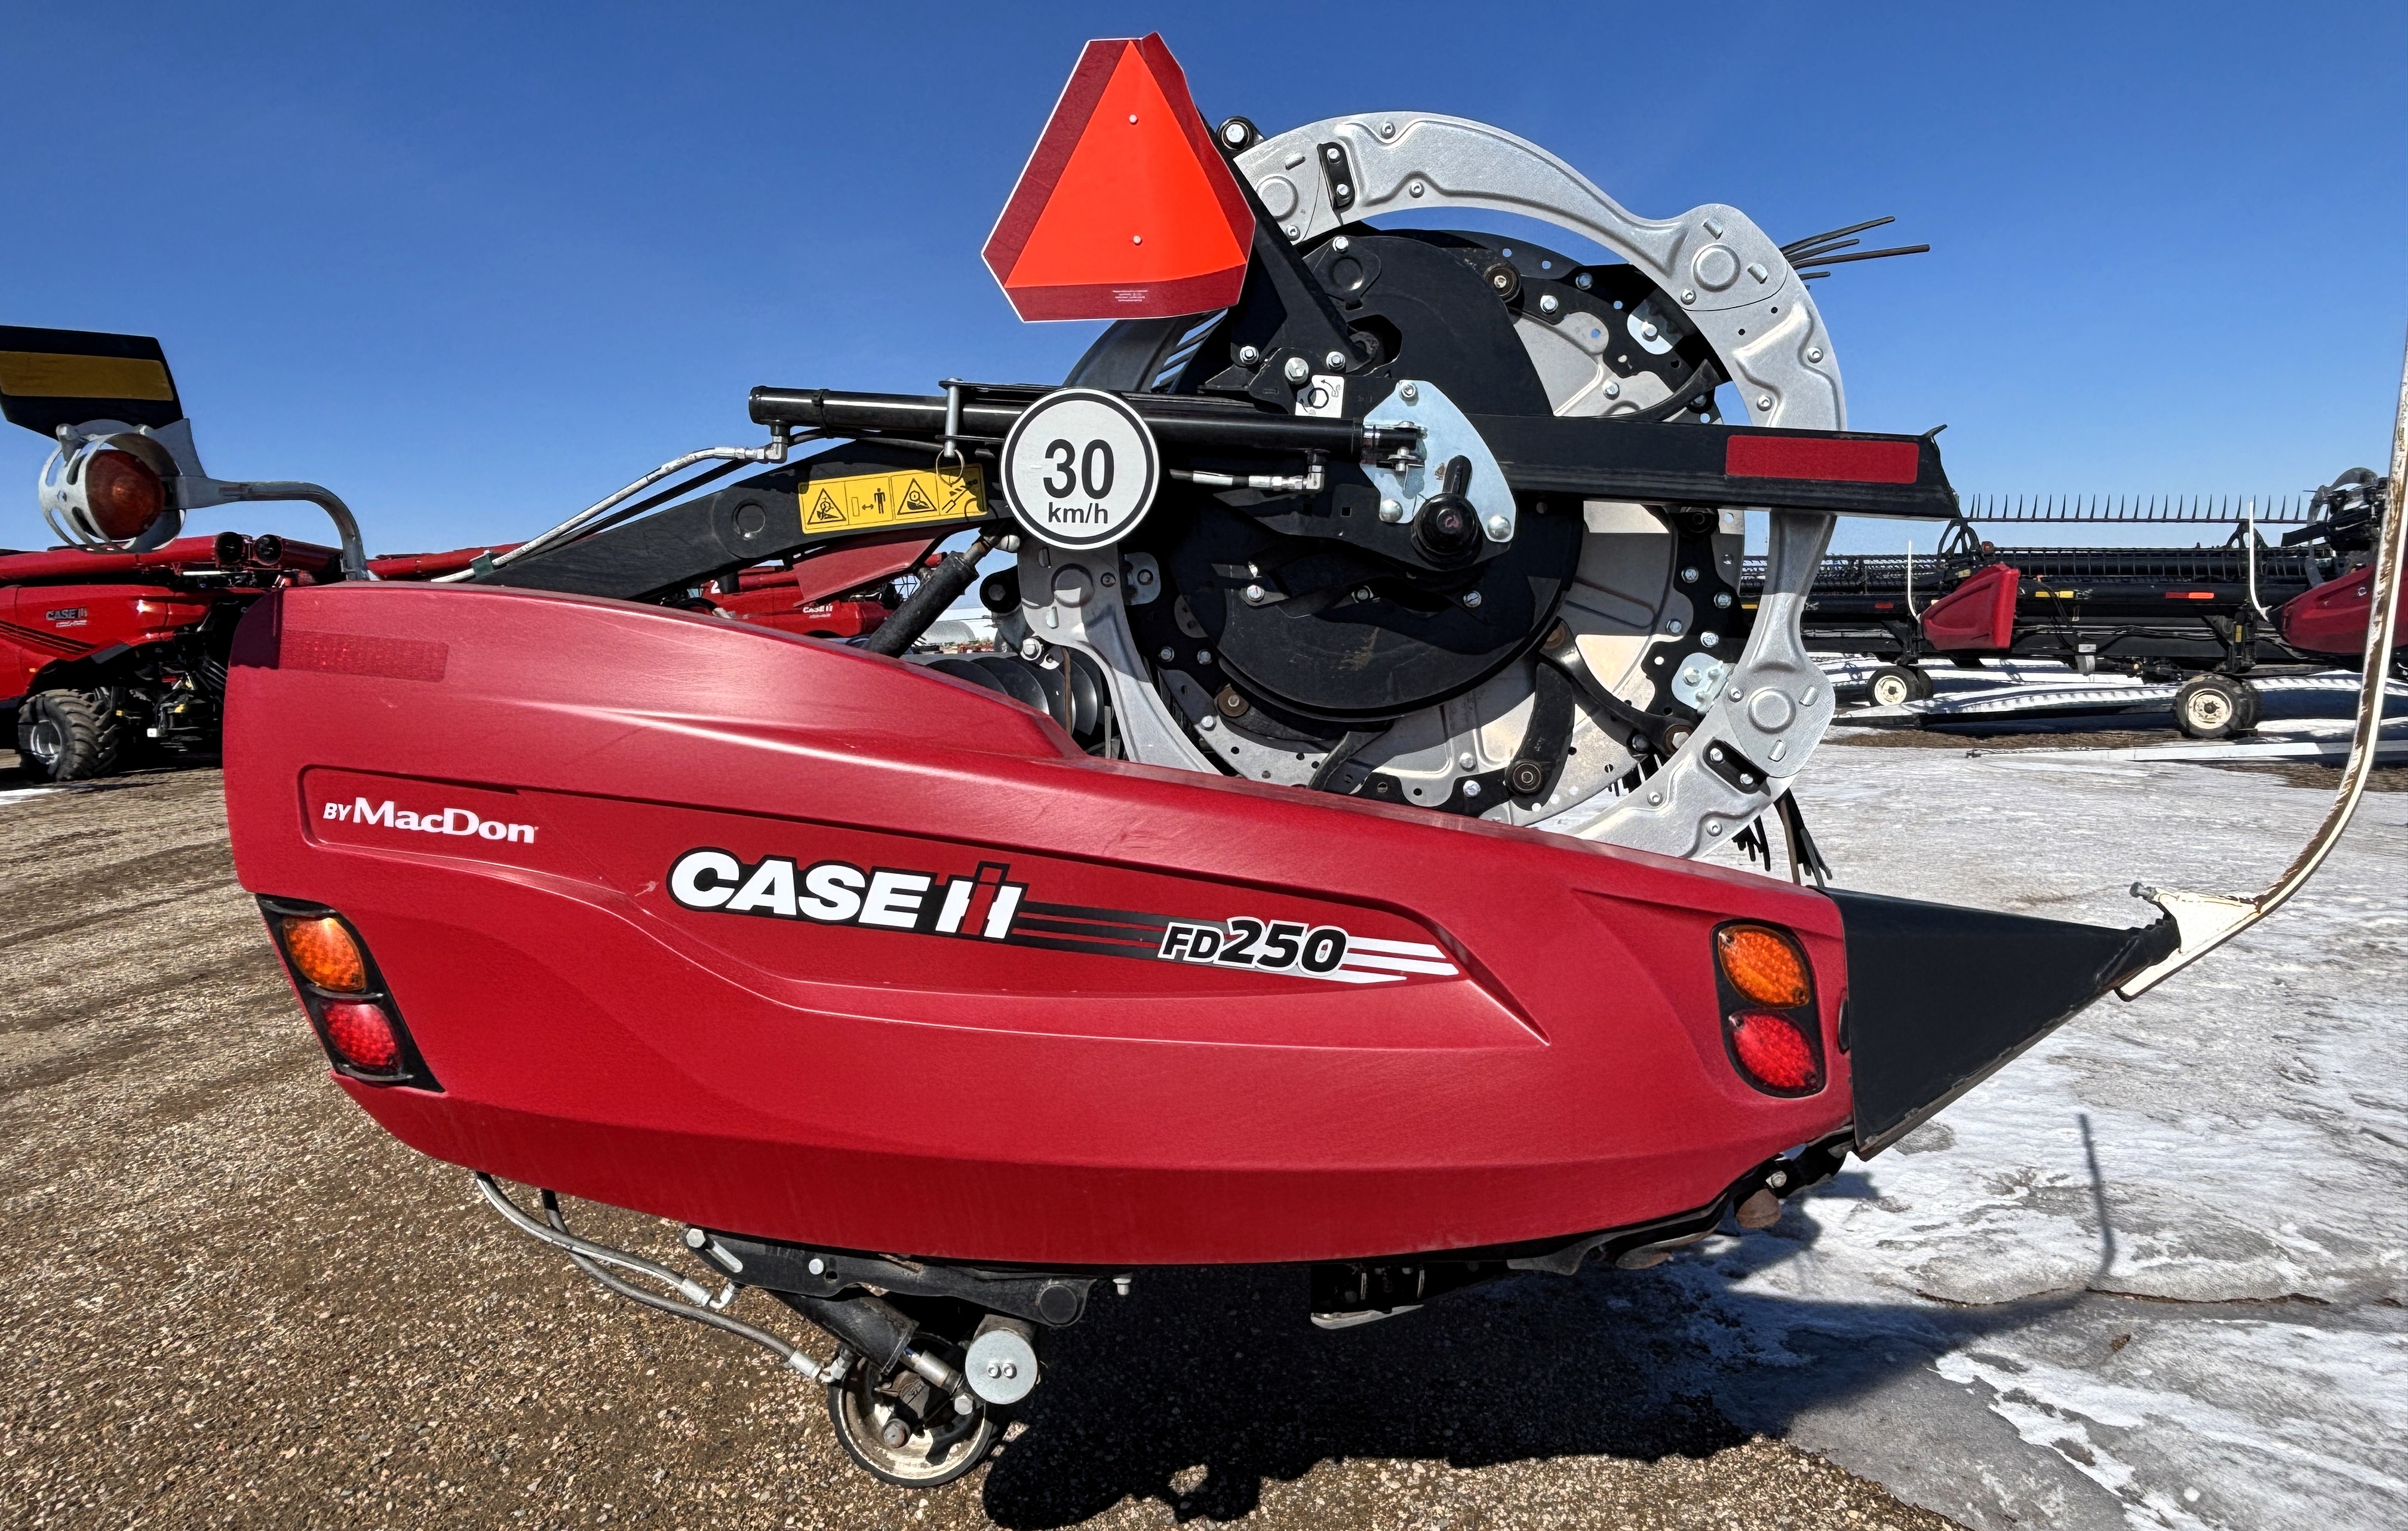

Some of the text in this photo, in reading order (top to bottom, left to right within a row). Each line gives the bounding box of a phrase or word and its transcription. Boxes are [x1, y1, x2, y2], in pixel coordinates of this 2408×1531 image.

[1043, 438, 1114, 499] 30
[1048, 502, 1108, 524] km/h
[322, 796, 535, 844] BY MacDon
[670, 850, 932, 929] CASE
[1157, 916, 1350, 977] FD250
